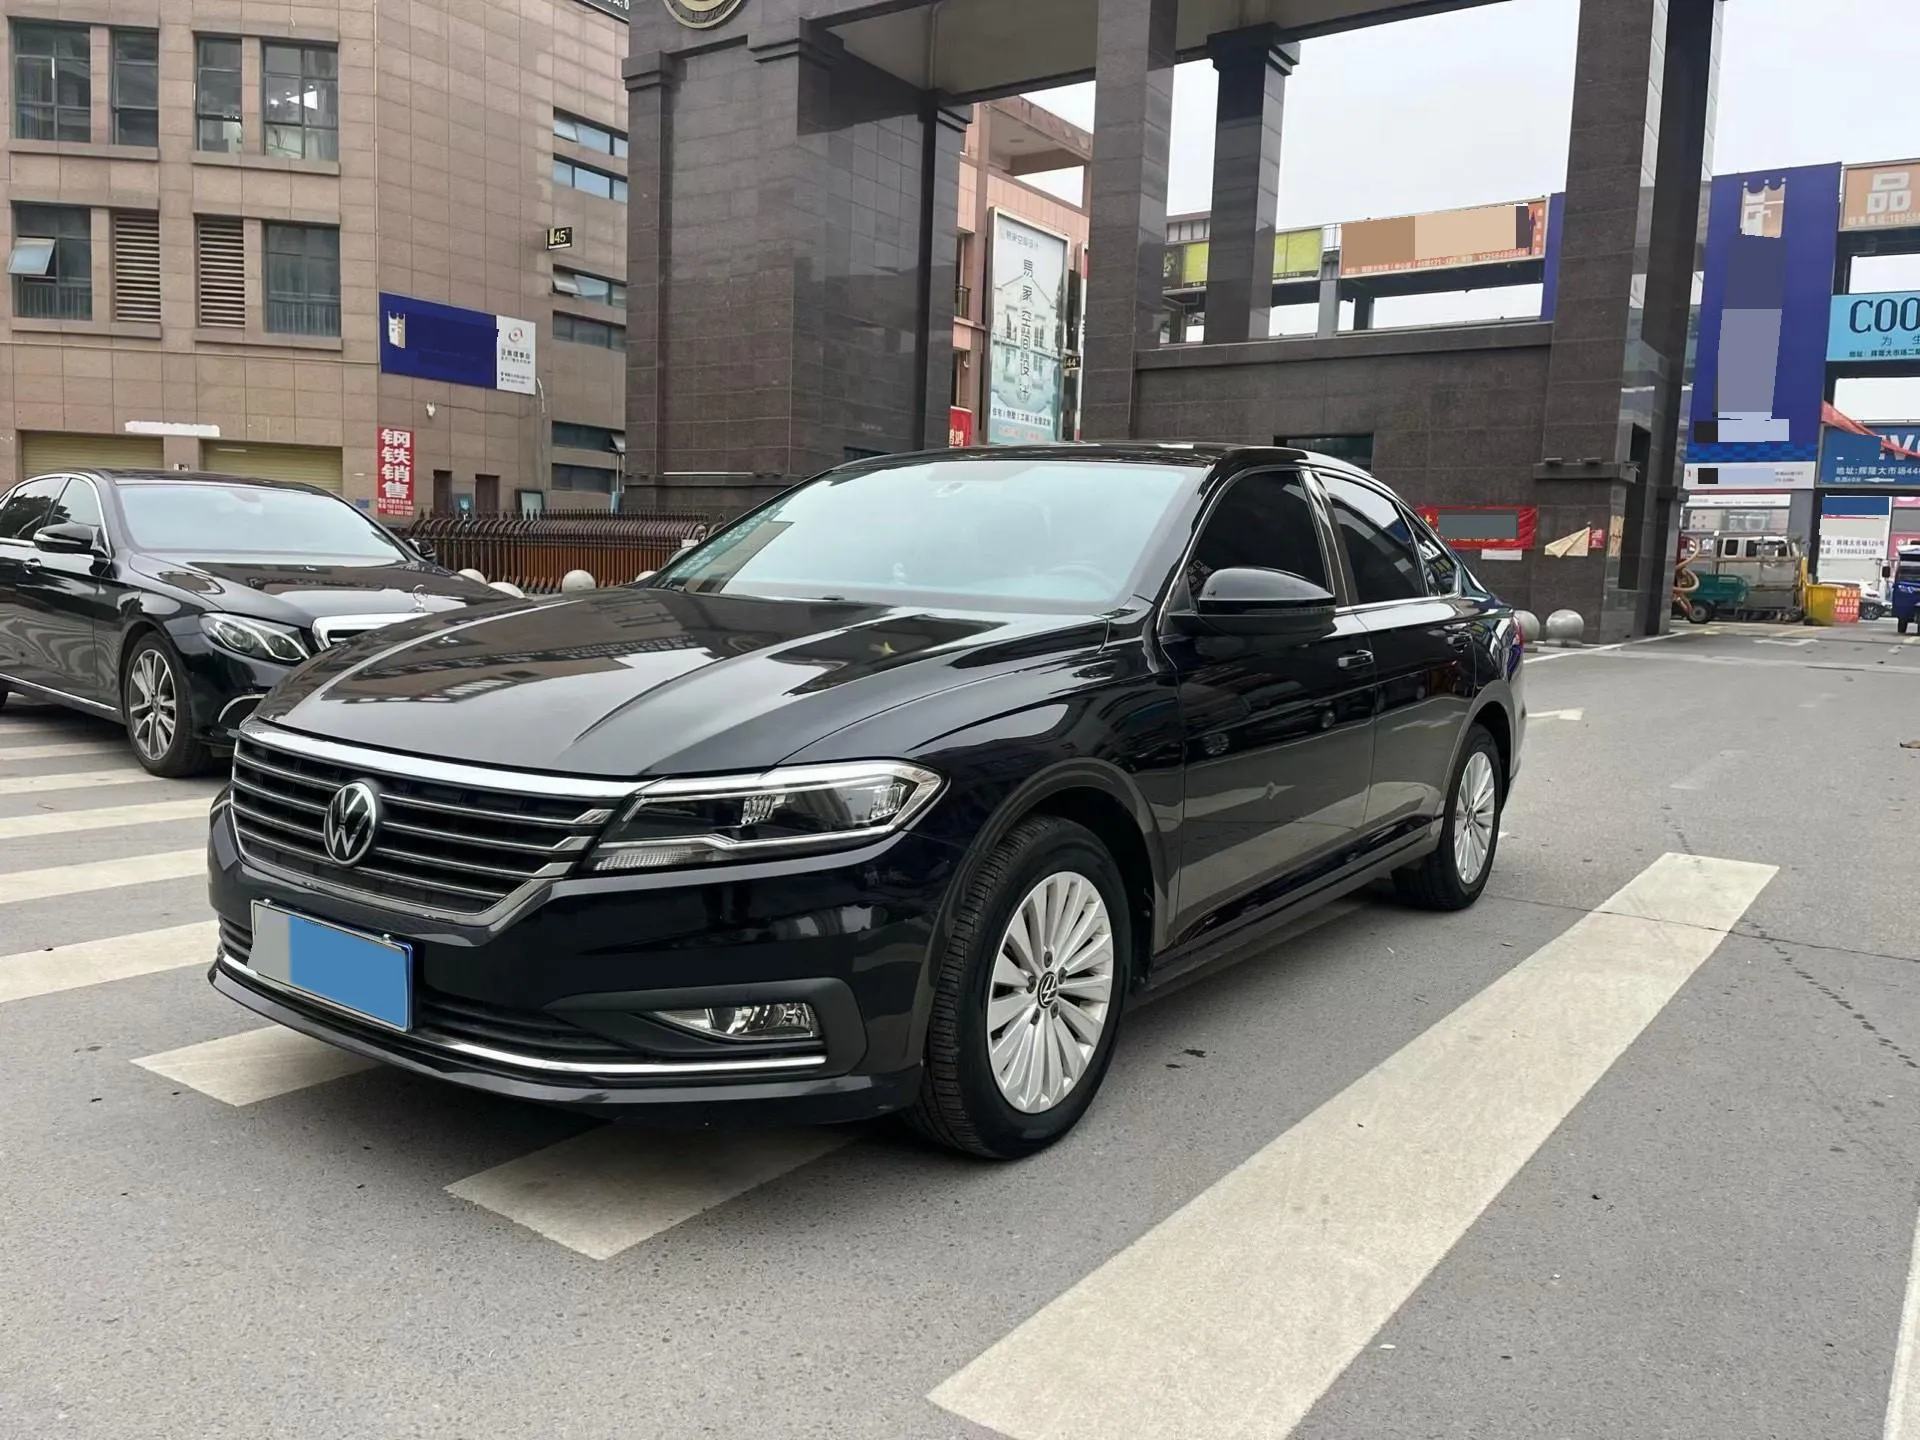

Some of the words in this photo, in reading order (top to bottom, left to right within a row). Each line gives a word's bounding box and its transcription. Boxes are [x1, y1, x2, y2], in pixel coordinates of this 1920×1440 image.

[1866, 171, 1912, 214] 品
[380, 428, 411, 499] 钢铁销售
